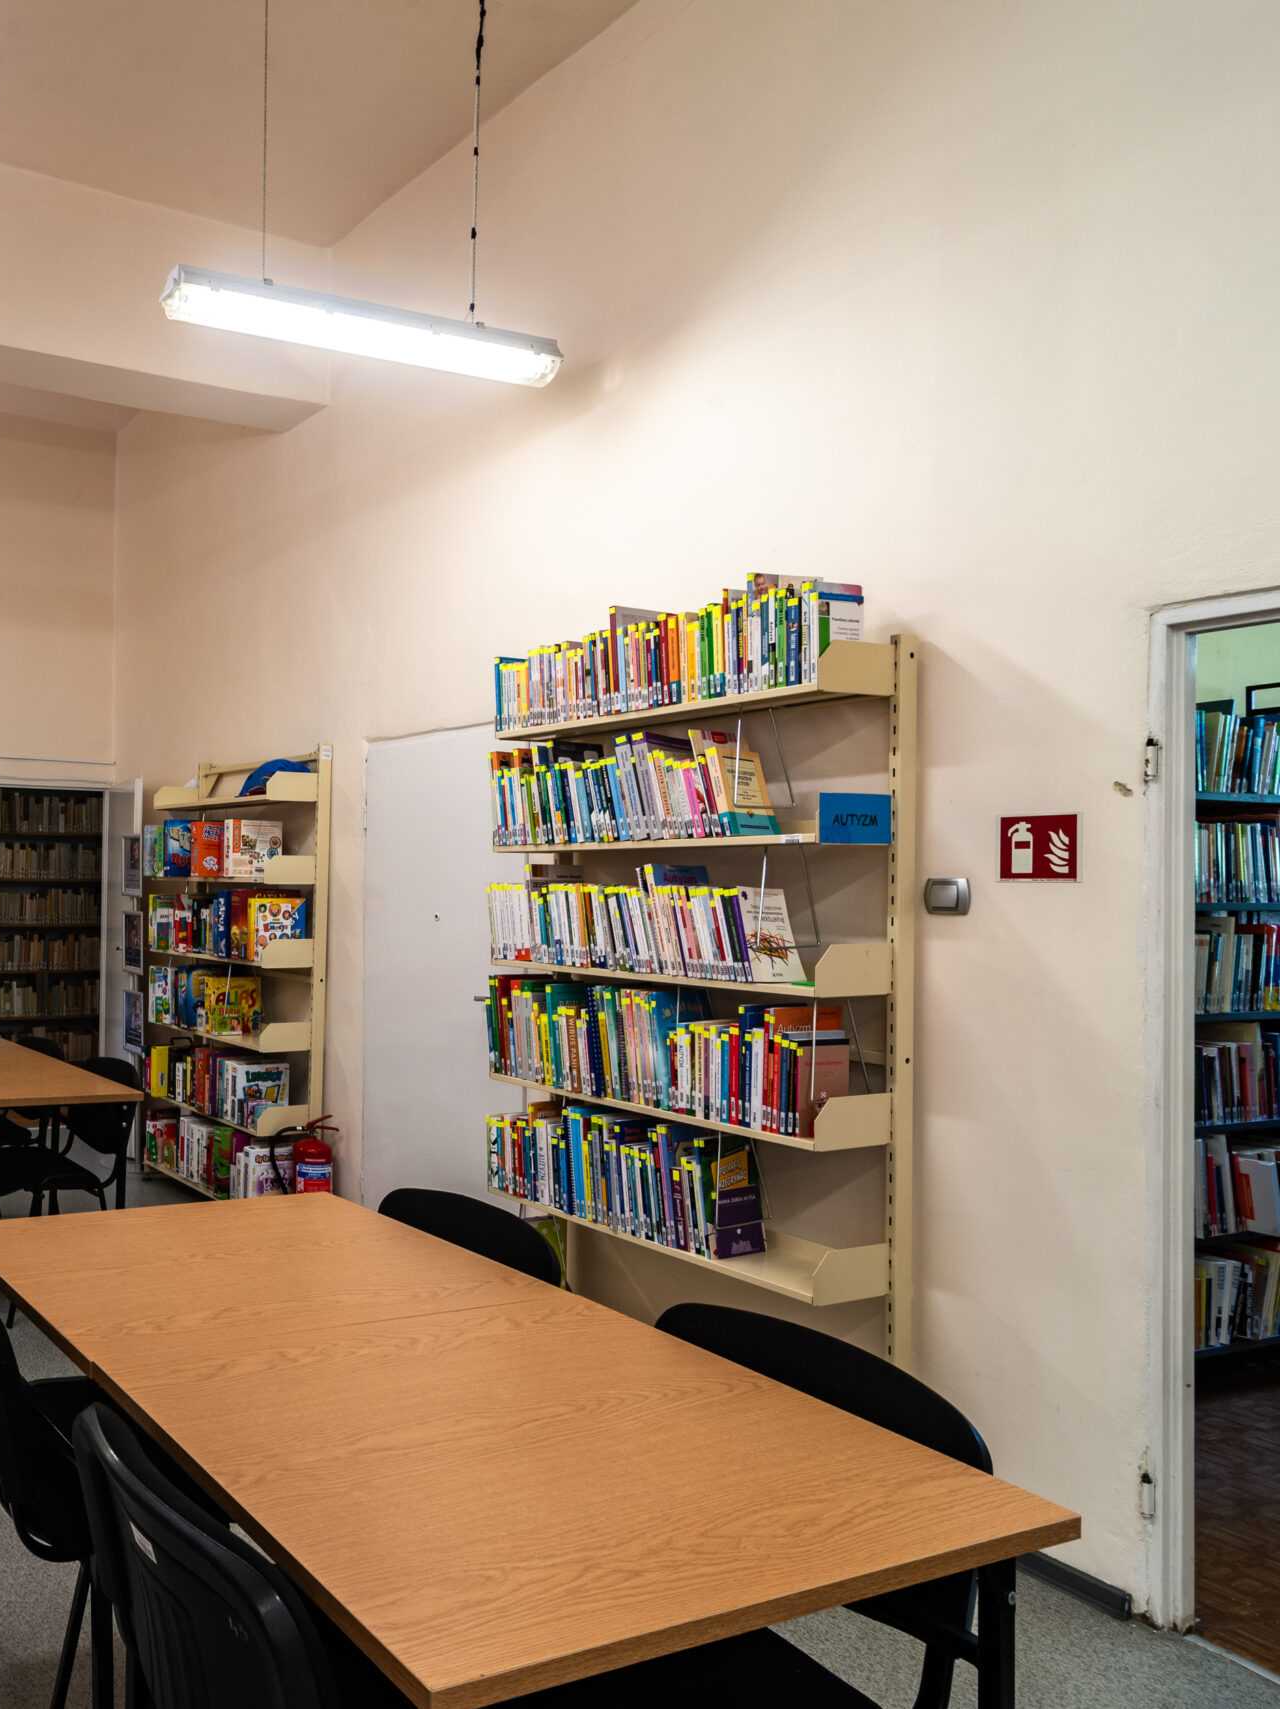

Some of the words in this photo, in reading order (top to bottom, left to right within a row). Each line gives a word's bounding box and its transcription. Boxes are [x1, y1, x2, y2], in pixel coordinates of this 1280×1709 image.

[832, 813, 879, 827] AUTYZM
[663, 872, 698, 886] Autyzm
[568, 1017, 576, 1045] WIRUS
[777, 1023, 811, 1034] Autyzm
